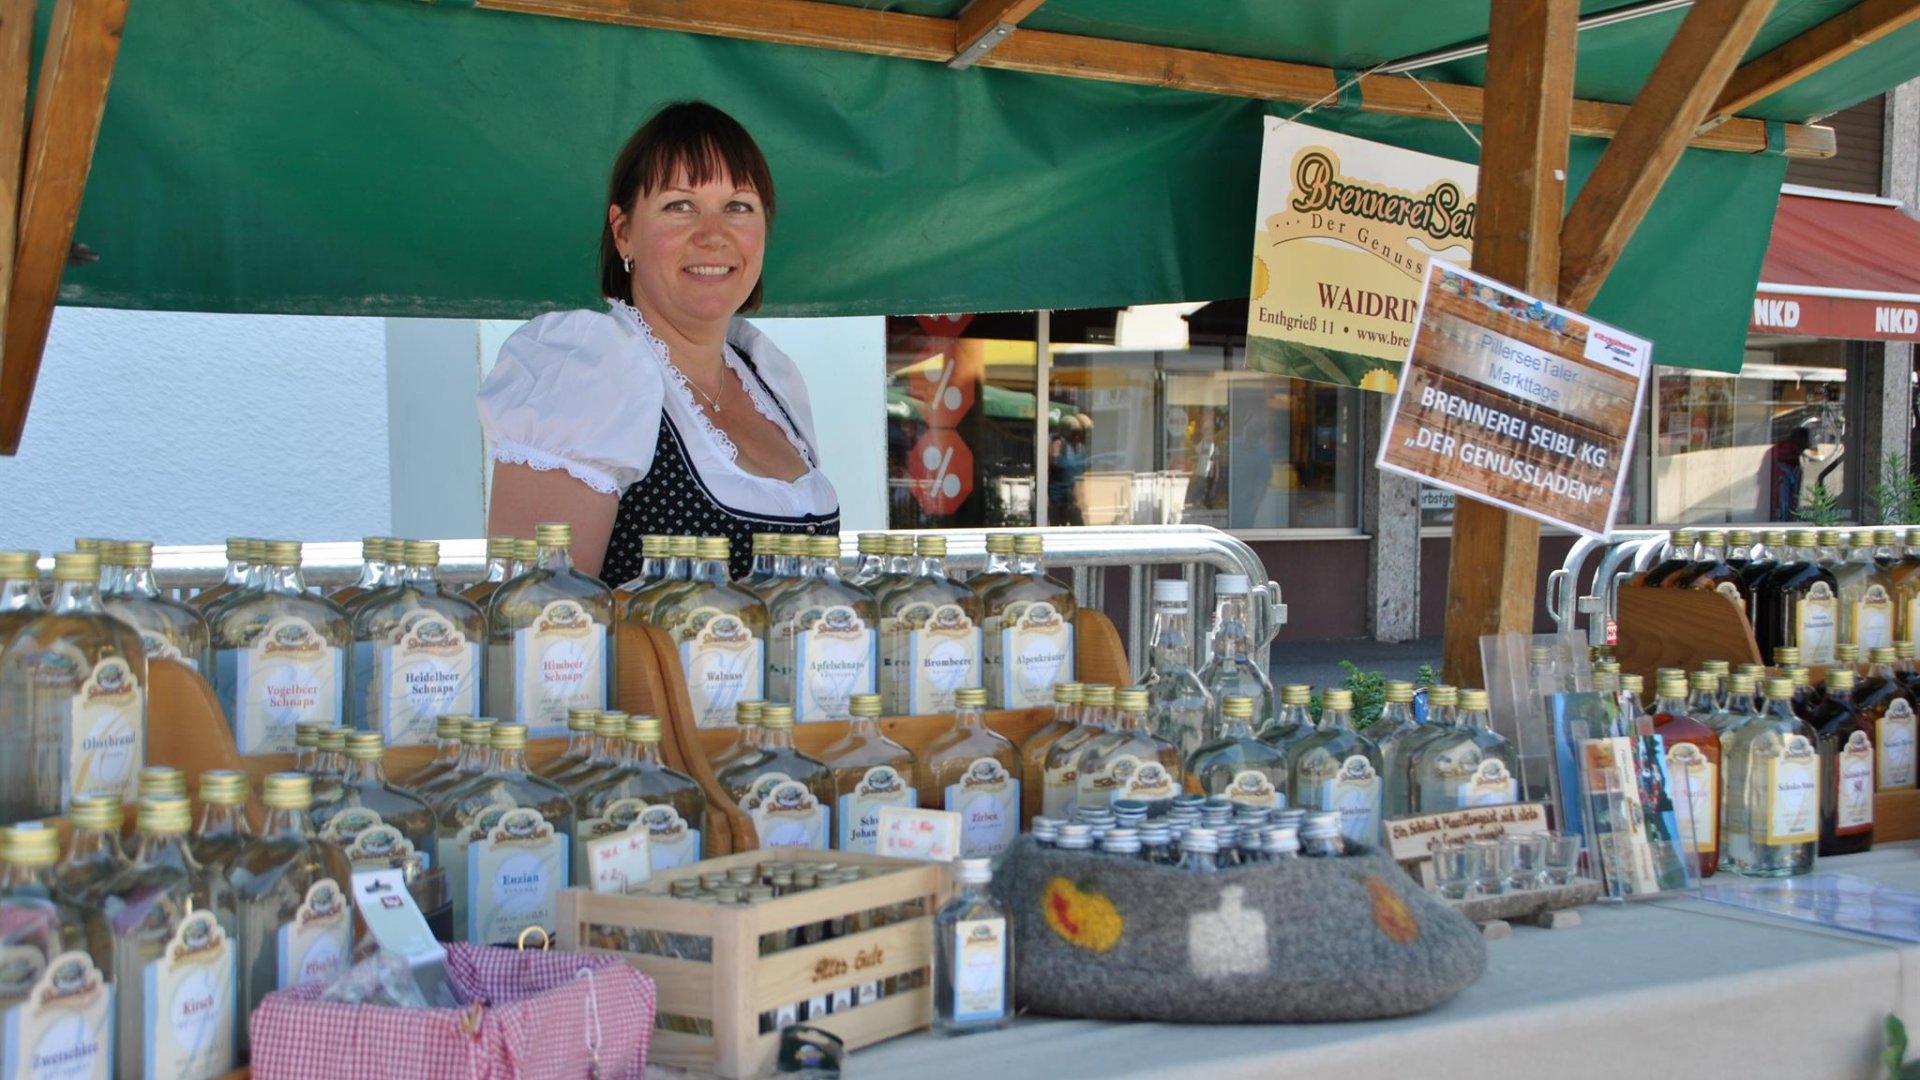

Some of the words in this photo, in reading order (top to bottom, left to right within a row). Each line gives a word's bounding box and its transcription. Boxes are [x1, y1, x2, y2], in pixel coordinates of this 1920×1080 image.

[1293, 152, 1476, 239] BrennereiSei
[1312, 213, 1346, 234] Der
[1258, 306, 1318, 332] Enthgrieß
[1321, 319, 1335, 335] 11
[1753, 298, 1800, 328] NKD
[1875, 306, 1919, 334] NKD
[1488, 362, 1560, 403] Markttage
[1421, 387, 1526, 440] BRENNEREI
[1528, 424, 1576, 458] SEIBL
[1577, 441, 1607, 468] KG
[544, 660, 584, 671] Himbeer
[809, 659, 865, 672] Apfelschnaps
[924, 656, 973, 667] Brombeere
[405, 671, 460, 683] Heidelbeer
[544, 672, 583, 683] Schnaps
[707, 671, 743, 682] Walnuss
[266, 685, 318, 697] Vogelbeer
[411, 685, 453, 695] Schnaps
[270, 697, 314, 709] Schnaps
[83, 731, 136, 751] Obstbrand
[503, 873, 539, 885] Enzian
[812, 956, 848, 984] Alles
[854, 944, 884, 971] Gute
[183, 994, 215, 1016] Kirsch
